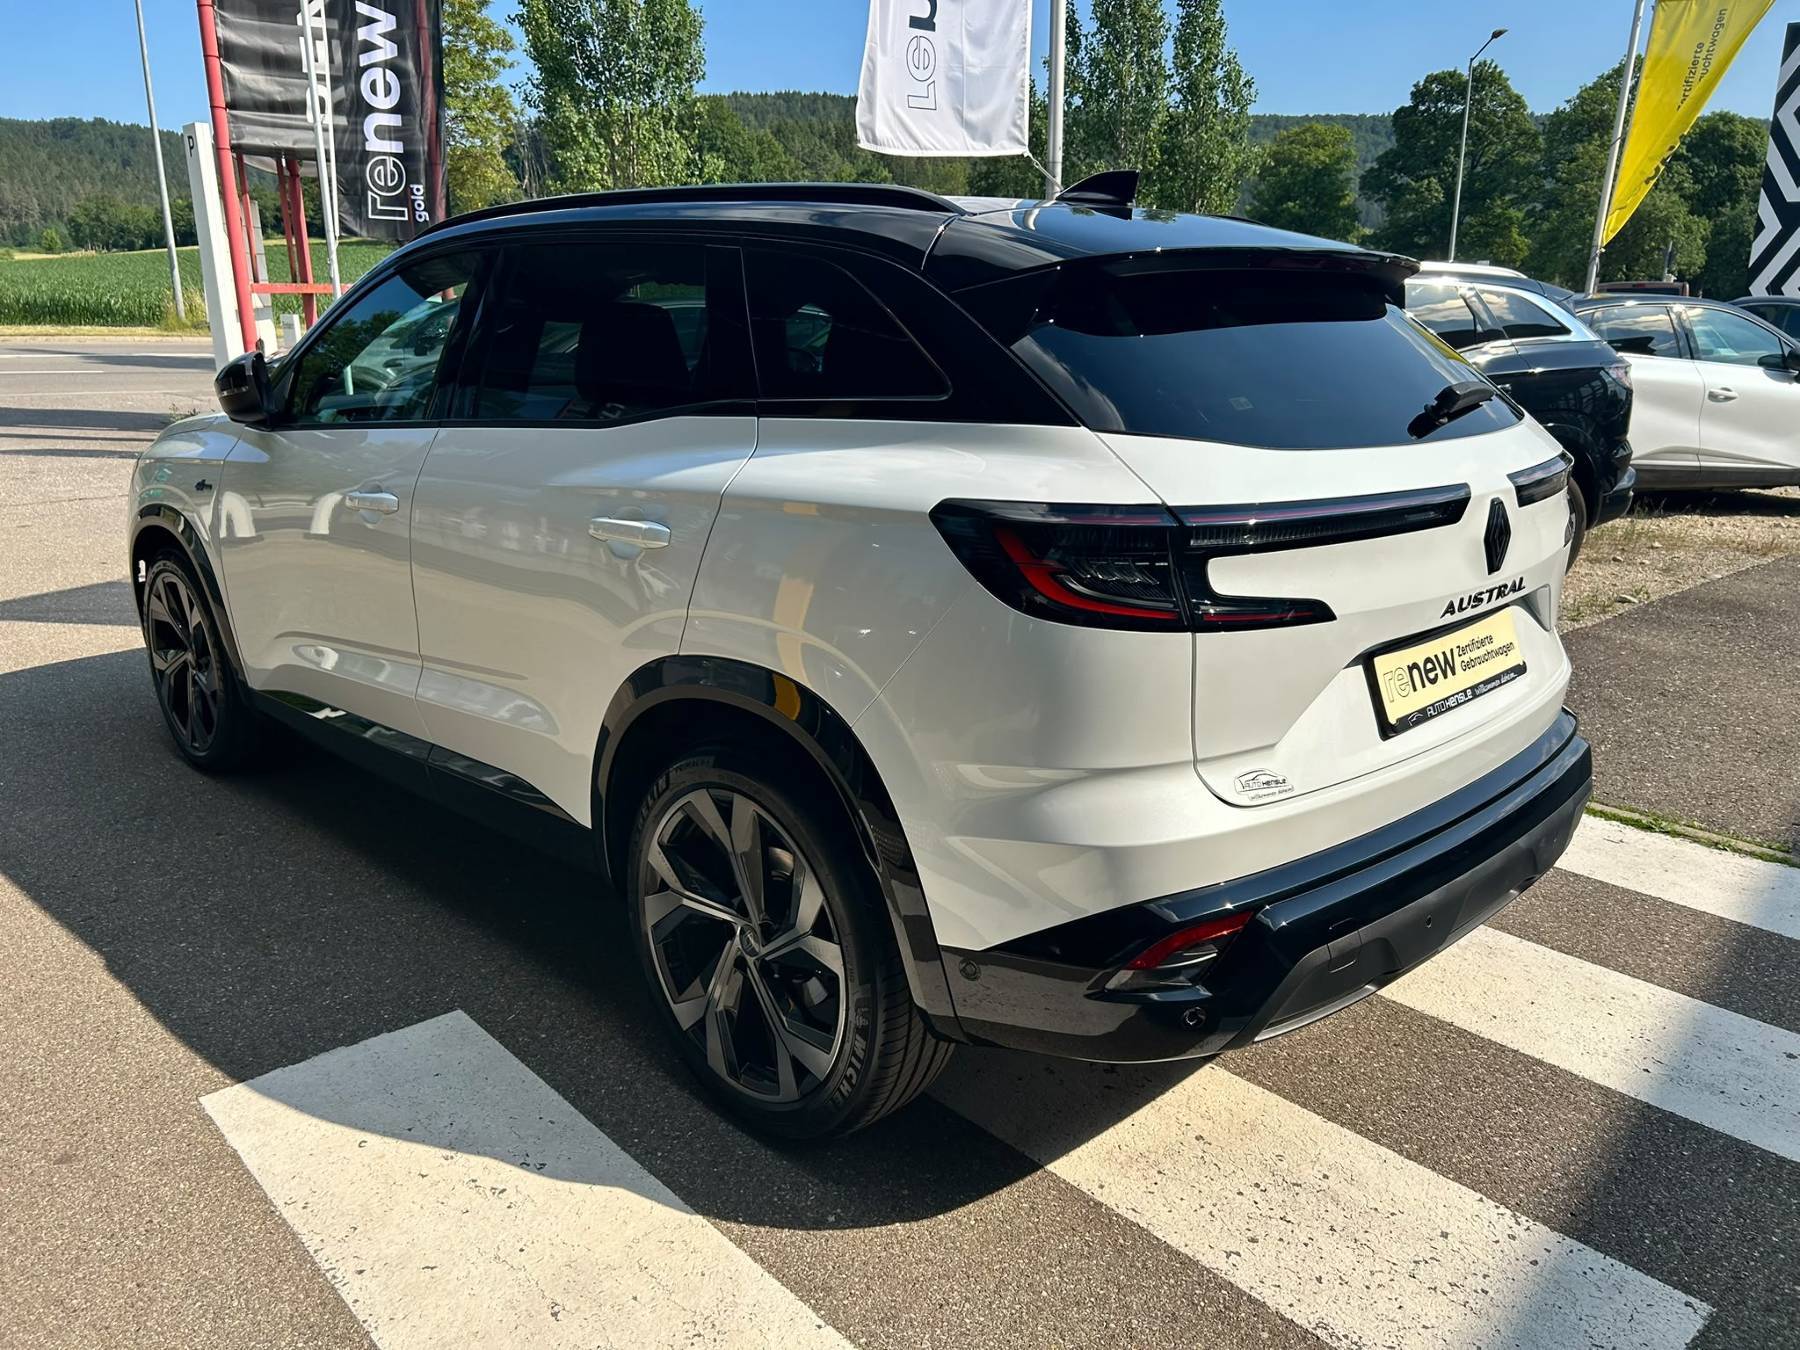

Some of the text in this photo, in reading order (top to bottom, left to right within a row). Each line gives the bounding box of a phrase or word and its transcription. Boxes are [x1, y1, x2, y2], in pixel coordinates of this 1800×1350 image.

[1676, 41, 1705, 112] rtifizierte
[355, 0, 409, 222] renew
[409, 183, 430, 223] gold
[1440, 576, 1526, 619] AUSTRAL
[1456, 634, 1494, 657] Zertifizierte
[1460, 641, 1515, 672] Gebrauchtwagen
[1383, 648, 1457, 704] renew
